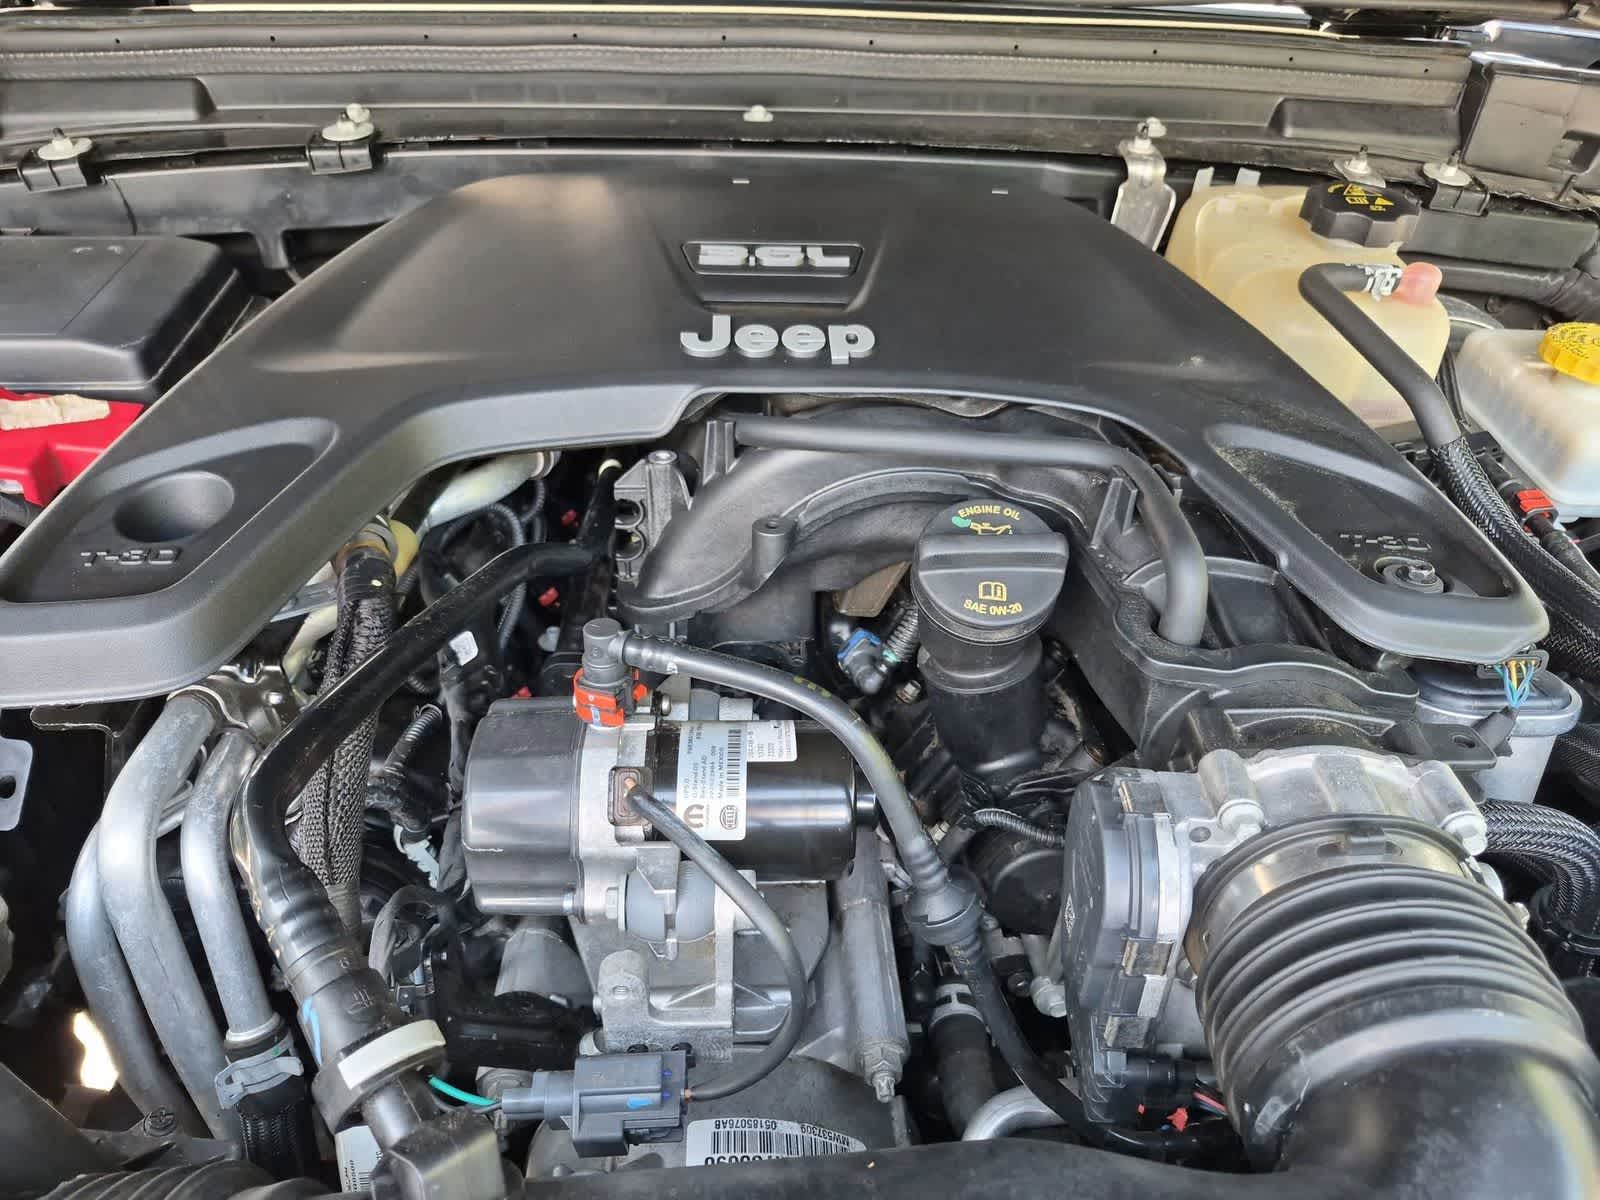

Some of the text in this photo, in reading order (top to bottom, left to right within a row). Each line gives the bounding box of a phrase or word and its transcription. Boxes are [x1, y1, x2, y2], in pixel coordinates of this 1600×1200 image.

[680, 314, 876, 365] Jeep
[958, 505, 1020, 520] ENGINE OIL
[963, 599, 1023, 616] SAE 0W-20
